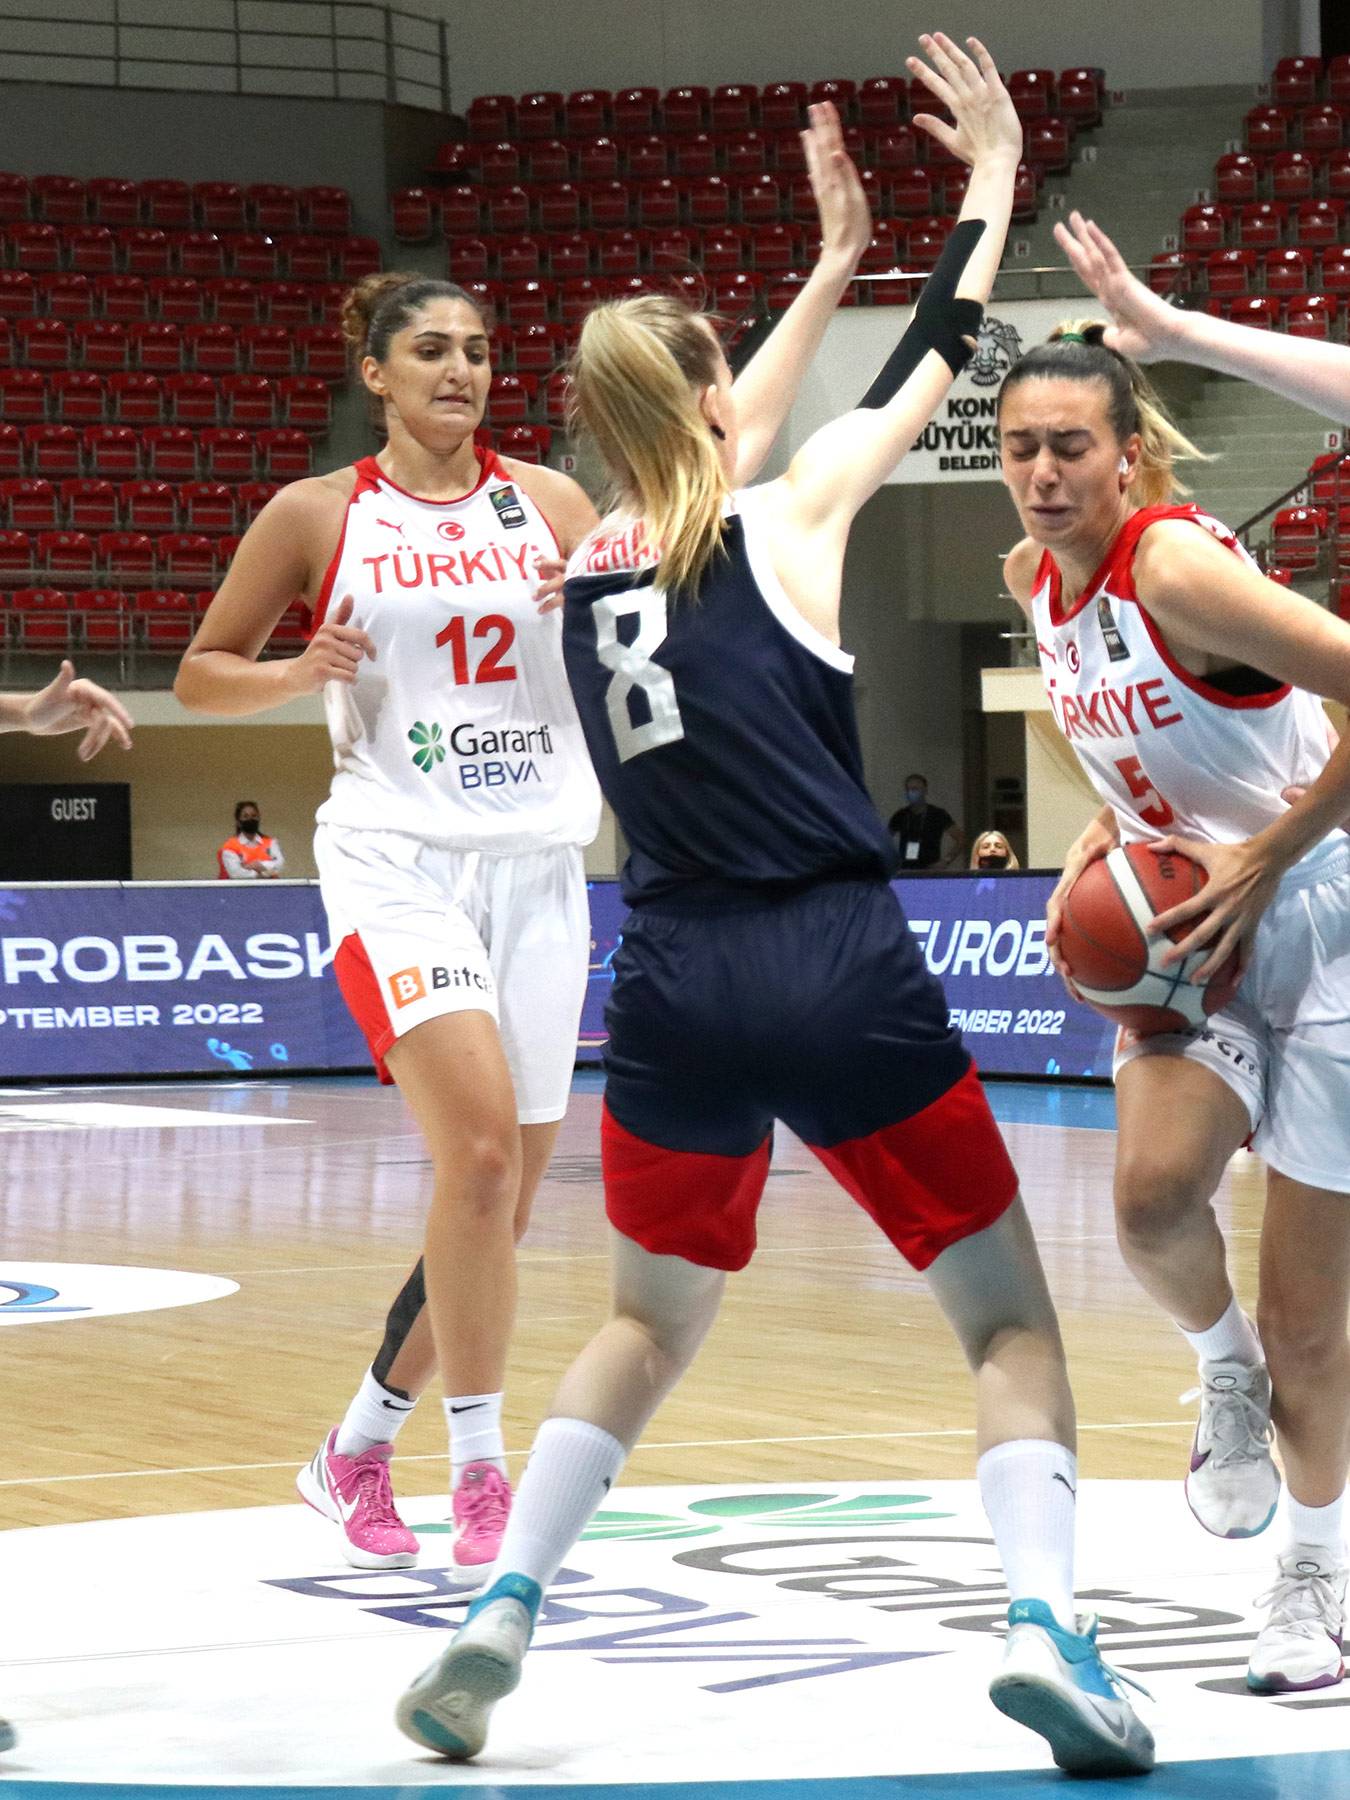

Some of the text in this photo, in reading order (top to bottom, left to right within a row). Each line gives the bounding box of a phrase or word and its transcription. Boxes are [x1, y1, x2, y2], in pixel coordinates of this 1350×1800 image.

[435, 613, 517, 686] 12
[592, 585, 684, 764] 8
[459, 759, 542, 789] BBVA
[1114, 755, 1174, 827] 5
[51, 798, 98, 820] GUEST
[172, 1003, 264, 1025] 2022
[1013, 1009, 1067, 1035] 2022
